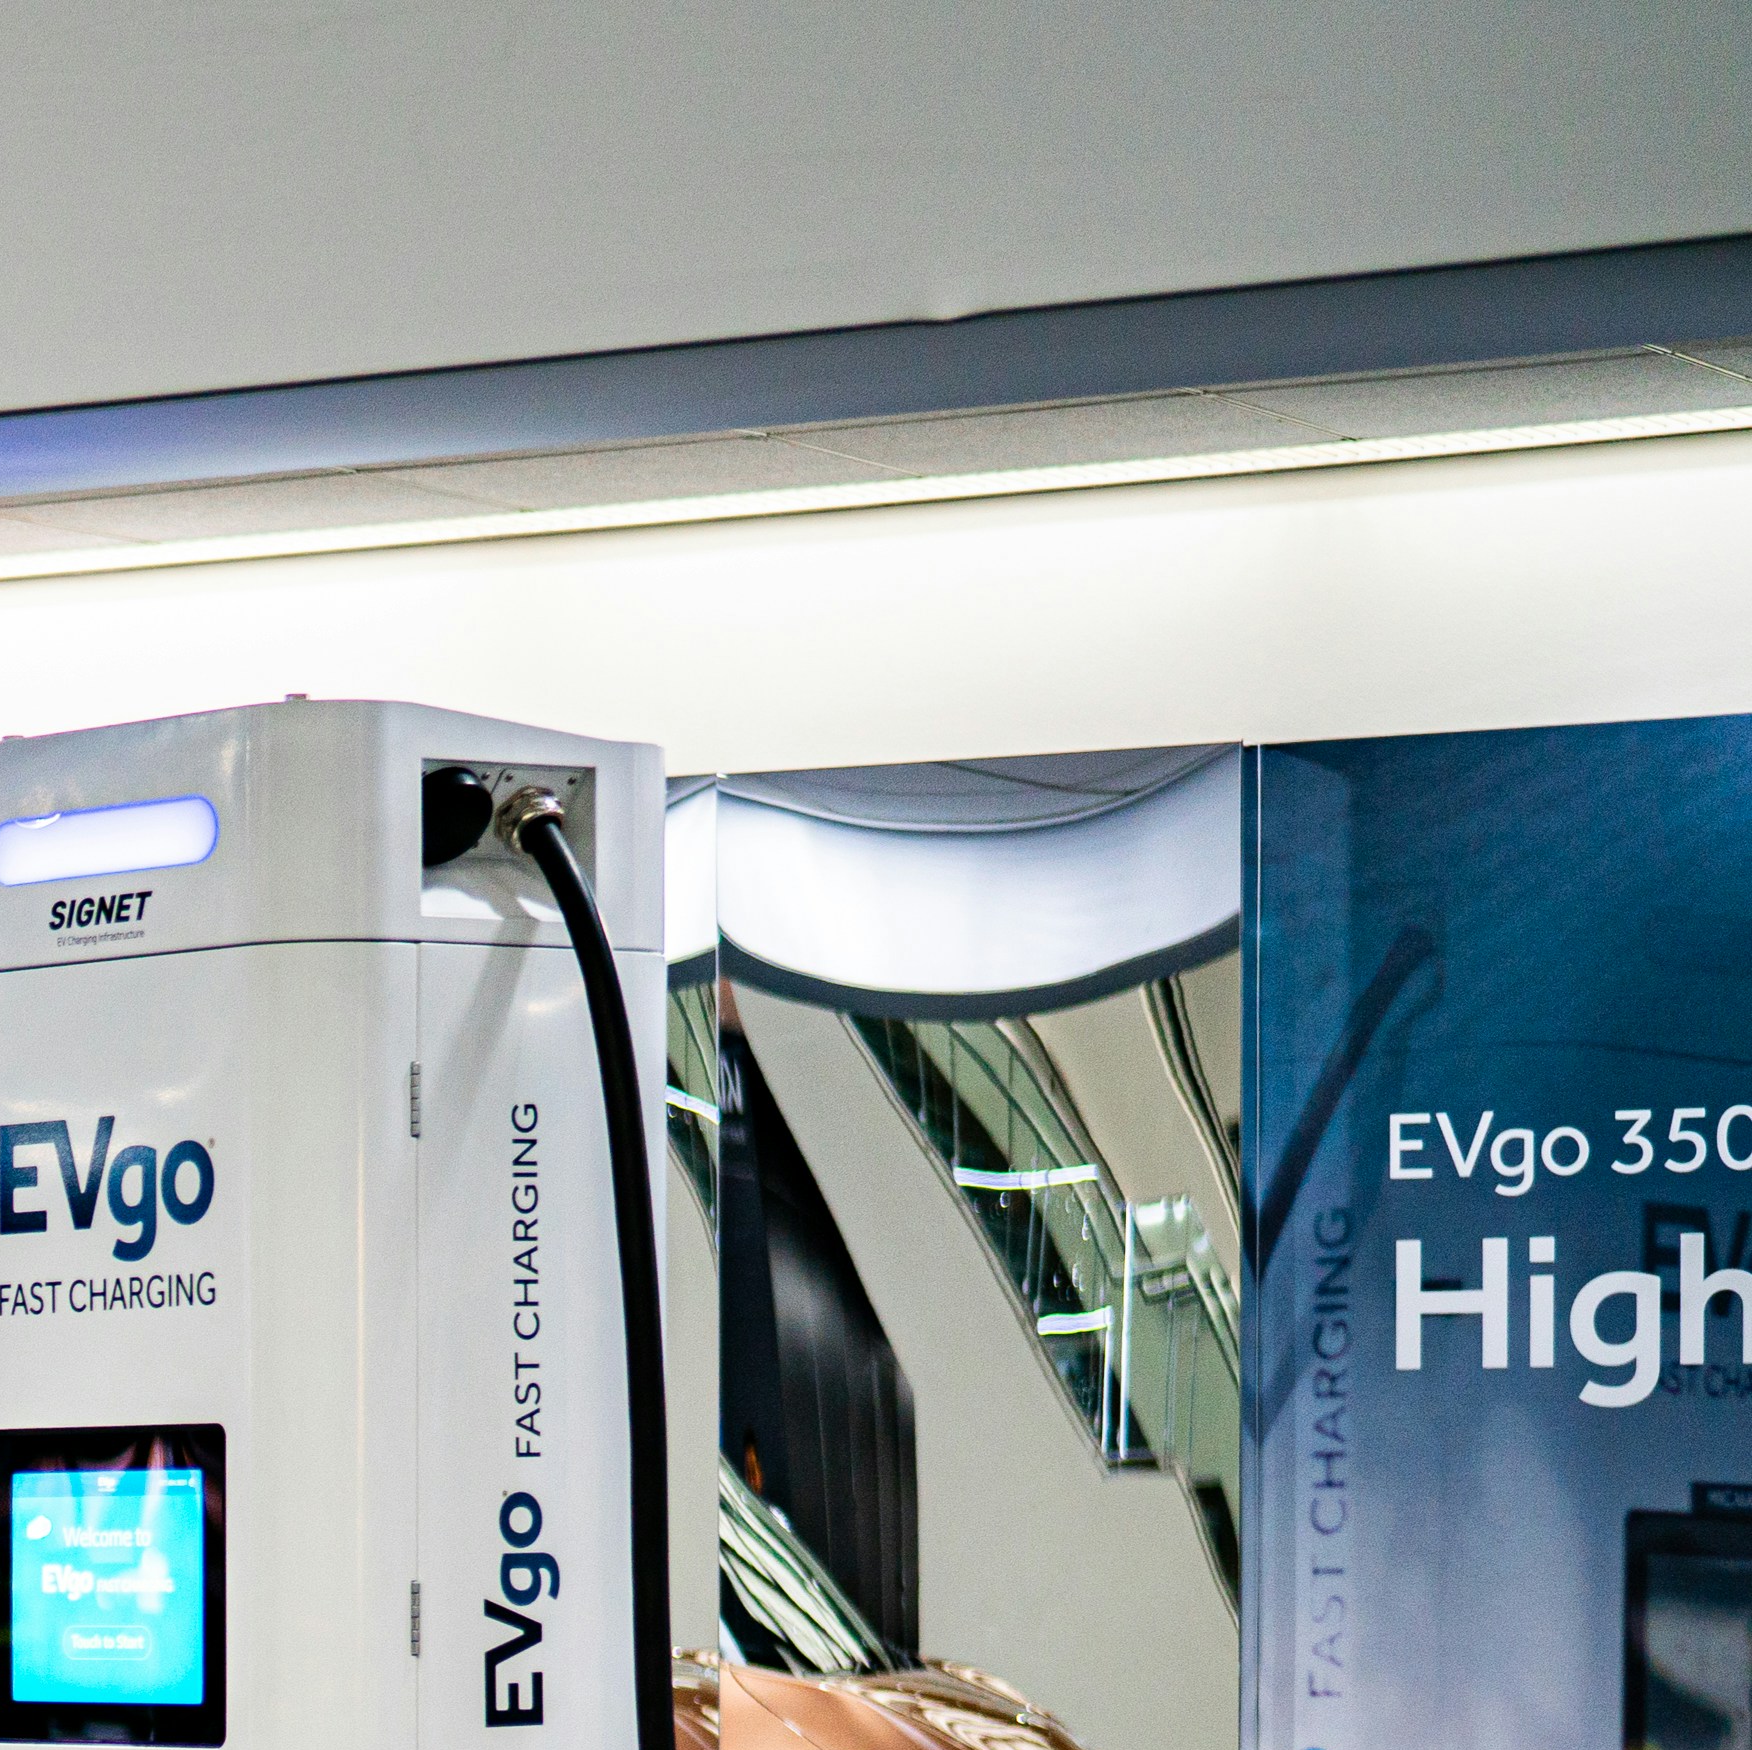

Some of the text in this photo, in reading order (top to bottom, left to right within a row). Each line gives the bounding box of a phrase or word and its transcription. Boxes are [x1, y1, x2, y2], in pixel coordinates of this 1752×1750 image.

[49, 891, 153, 930] SIGNET
[68, 935, 97, 947] Charging
[98, 930, 145, 942] Infrastructure
[1389, 1108, 1589, 1197] EVgo
[69, 1271, 217, 1312] CHARGING
[1394, 1231, 1752, 1408] High
[1310, 1207, 1353, 1535] CHARGING
[485, 1102, 560, 1728] EVgo FAST CHARGING
[62, 1526, 151, 1548] Welcome to
[41, 1563, 94, 1601] EVgo
[70, 1633, 102, 1649] Touch
[116, 1634, 145, 1649] Start
